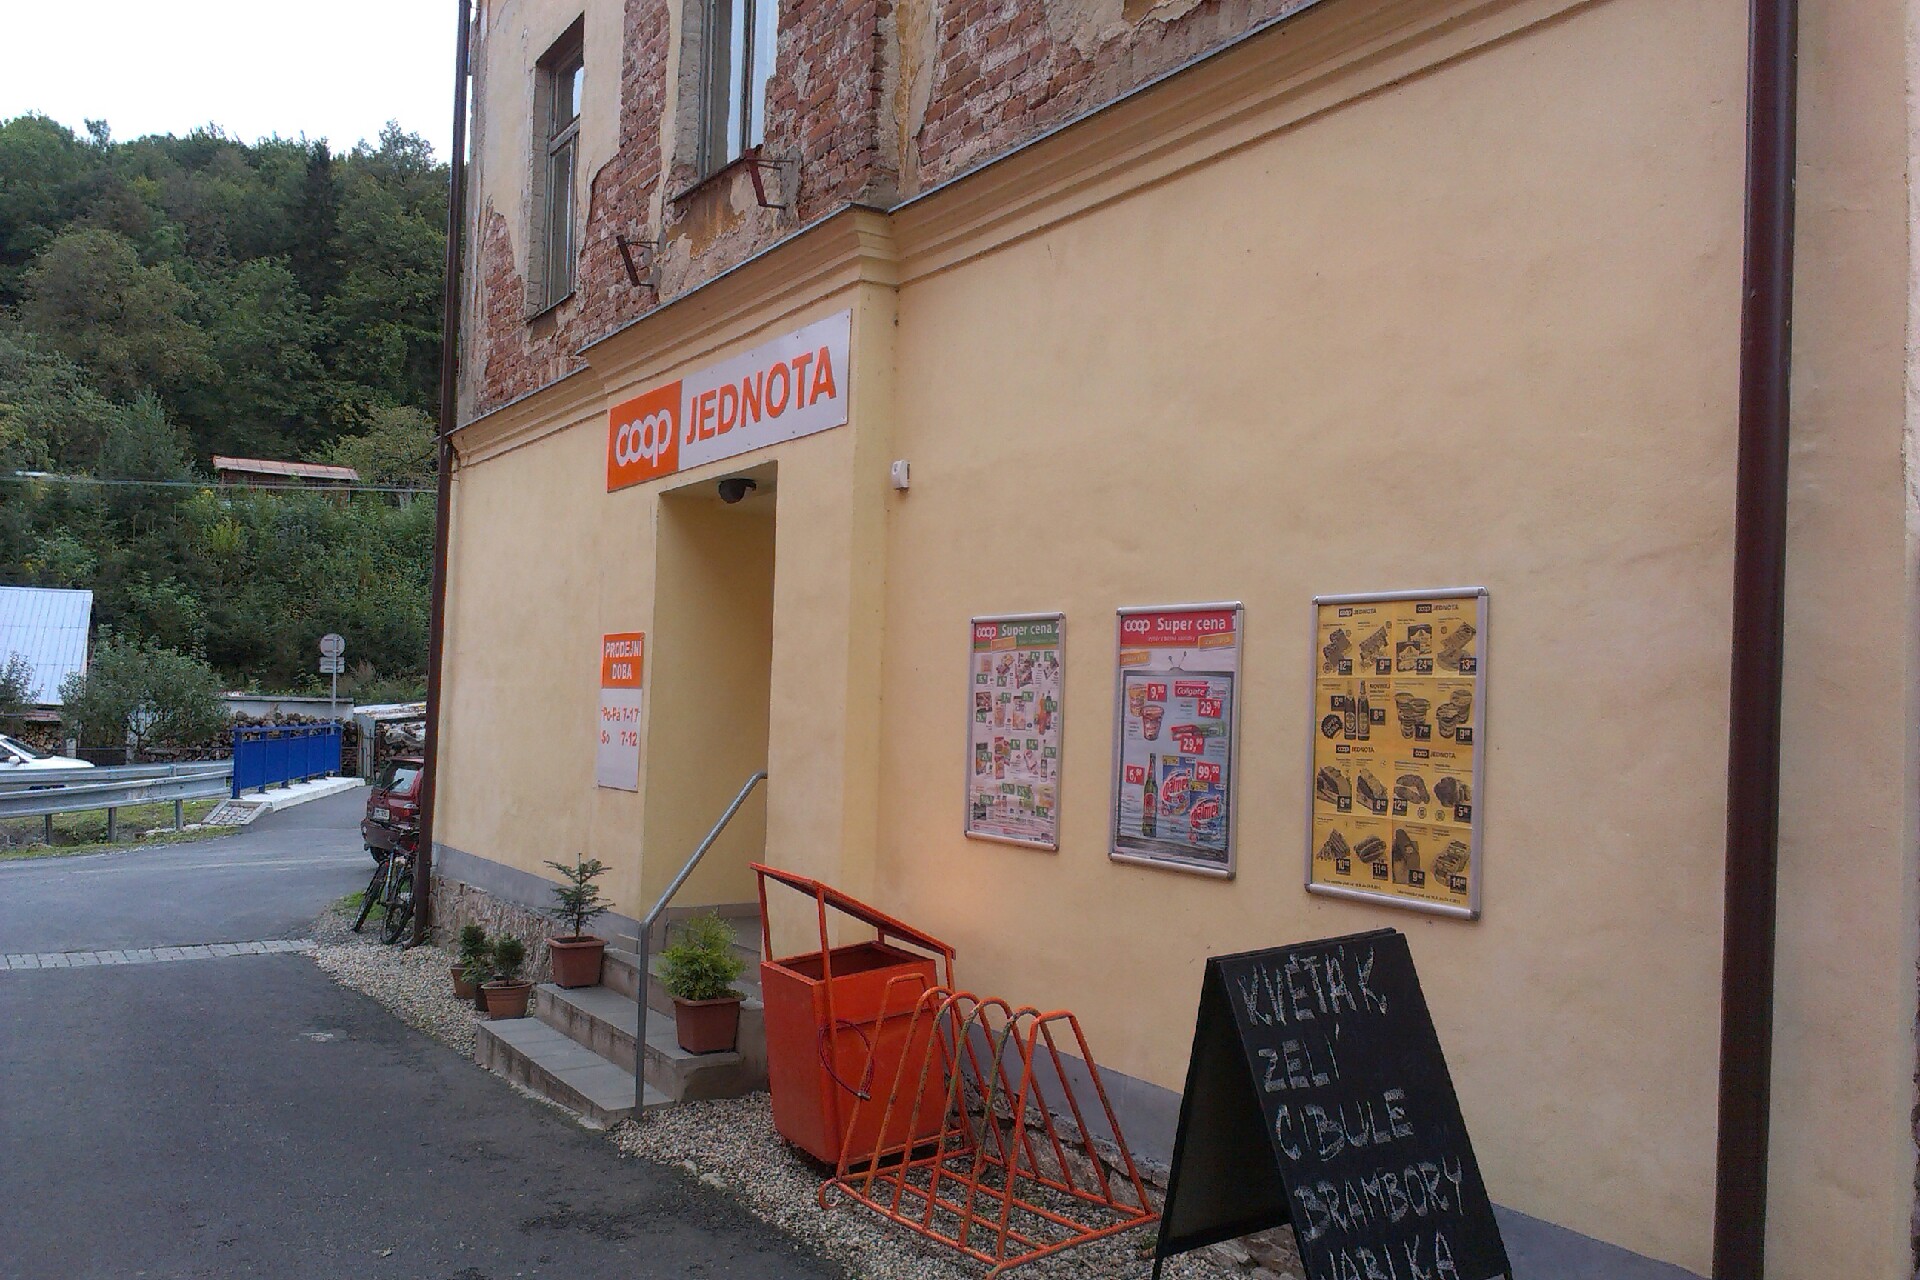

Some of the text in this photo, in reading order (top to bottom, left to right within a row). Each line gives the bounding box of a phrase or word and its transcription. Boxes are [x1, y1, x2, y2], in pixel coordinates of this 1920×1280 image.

[615, 345, 837, 467] coop JEDNOTA
[976, 626, 997, 639] coop
[1001, 624, 1028, 636] Super
[1030, 623, 1053, 635] cena
[1123, 619, 1151, 634] coop
[1157, 617, 1193, 634] Super
[1196, 618, 1226, 631] cena
[612, 663, 632, 680] DOBA
[1177, 687, 1206, 697] Colgate
[601, 729, 610, 745] So
[1276, 1088, 1414, 1161] CIBULE
[1294, 1156, 1464, 1243] BRAMBORY
